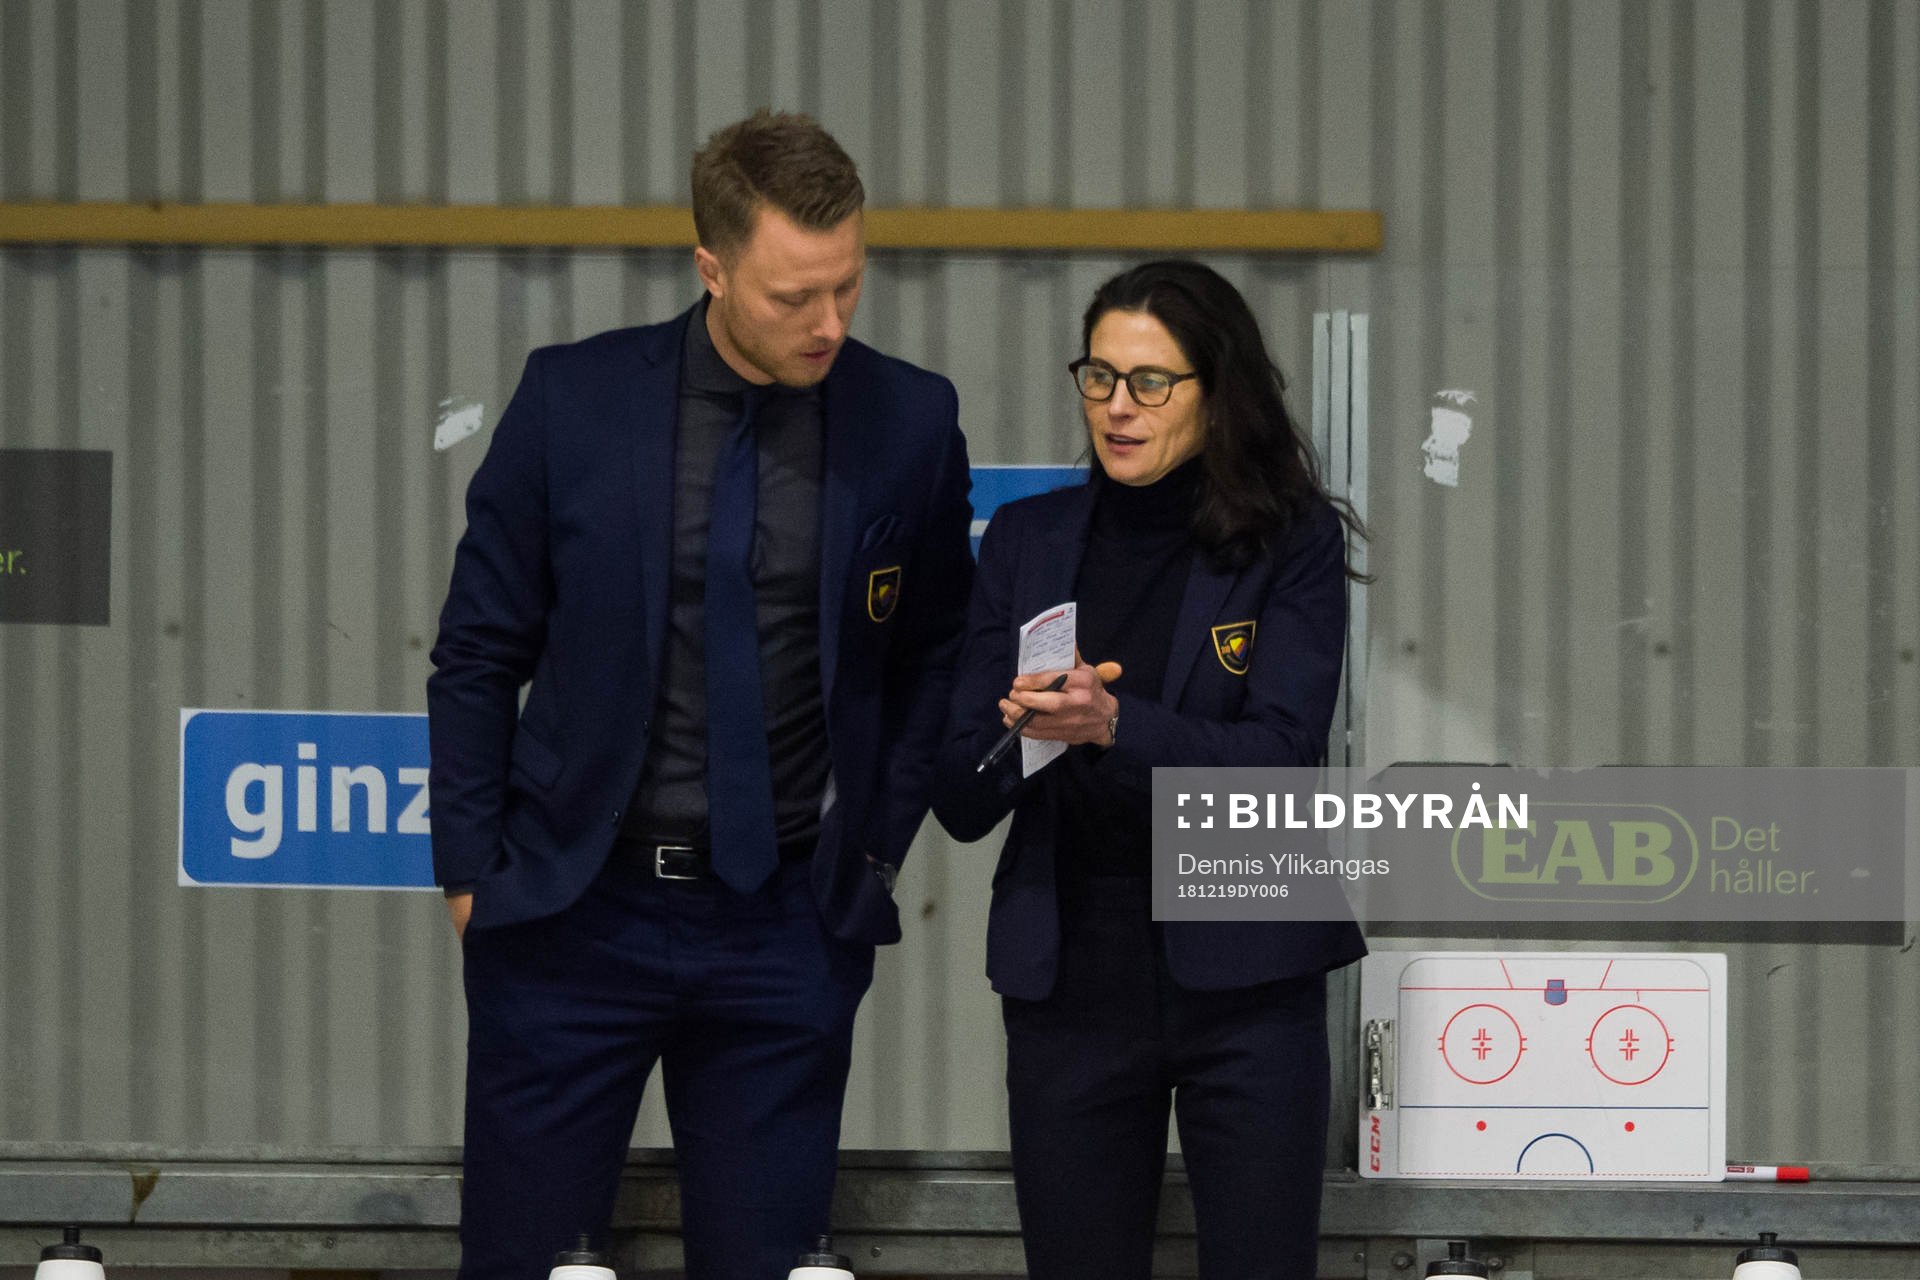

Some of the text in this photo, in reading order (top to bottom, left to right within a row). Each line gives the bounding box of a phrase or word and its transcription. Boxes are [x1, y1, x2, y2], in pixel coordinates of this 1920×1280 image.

[225, 742, 431, 859] ginz
[1477, 819, 1676, 887] EAB
[1710, 816, 1781, 852] Det
[1710, 858, 1820, 895] håller.
[1370, 1114, 1381, 1172] CCM
